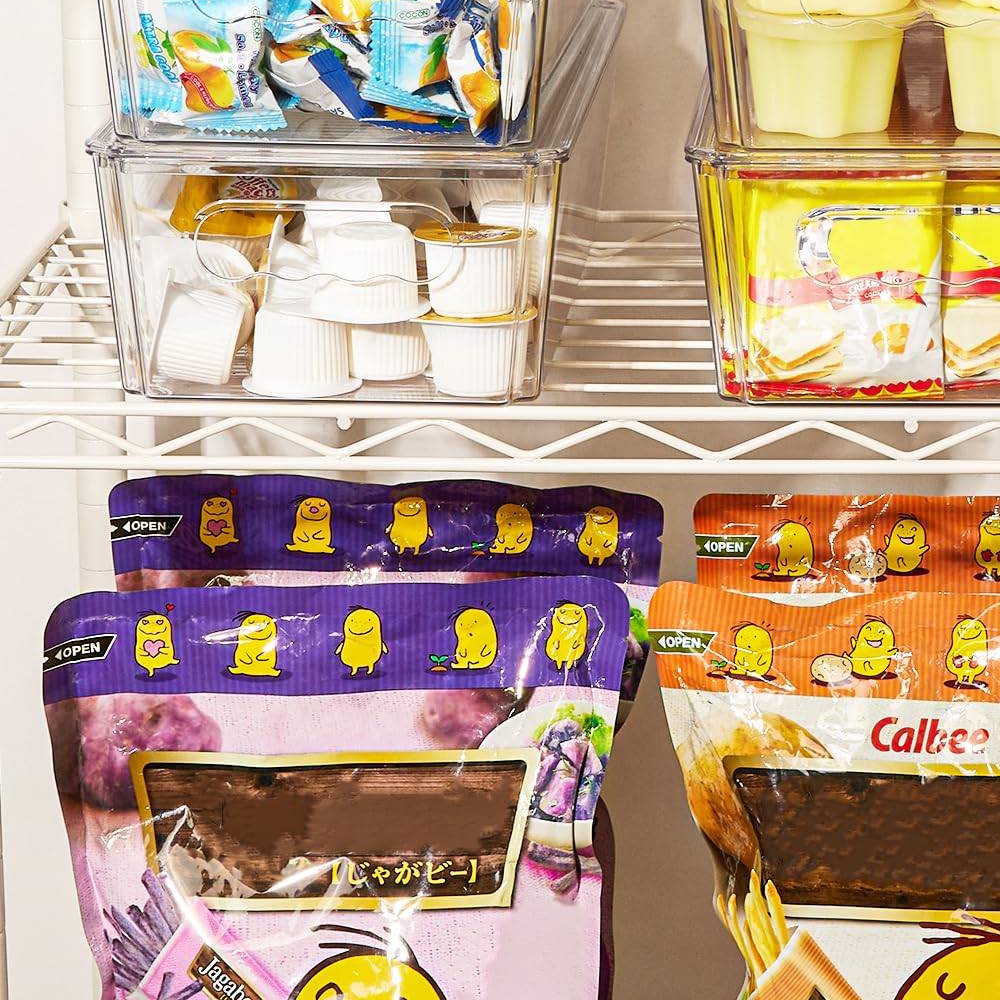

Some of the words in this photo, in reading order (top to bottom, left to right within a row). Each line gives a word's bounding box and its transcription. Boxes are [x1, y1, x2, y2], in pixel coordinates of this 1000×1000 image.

[399, 8, 430, 19] COCON
[131, 520, 167, 531] OPEN
[710, 541, 744, 553] OPEN
[666, 636, 700, 649] OPEN
[63, 641, 100, 658] OPEN
[871, 716, 990, 755] Calbee
